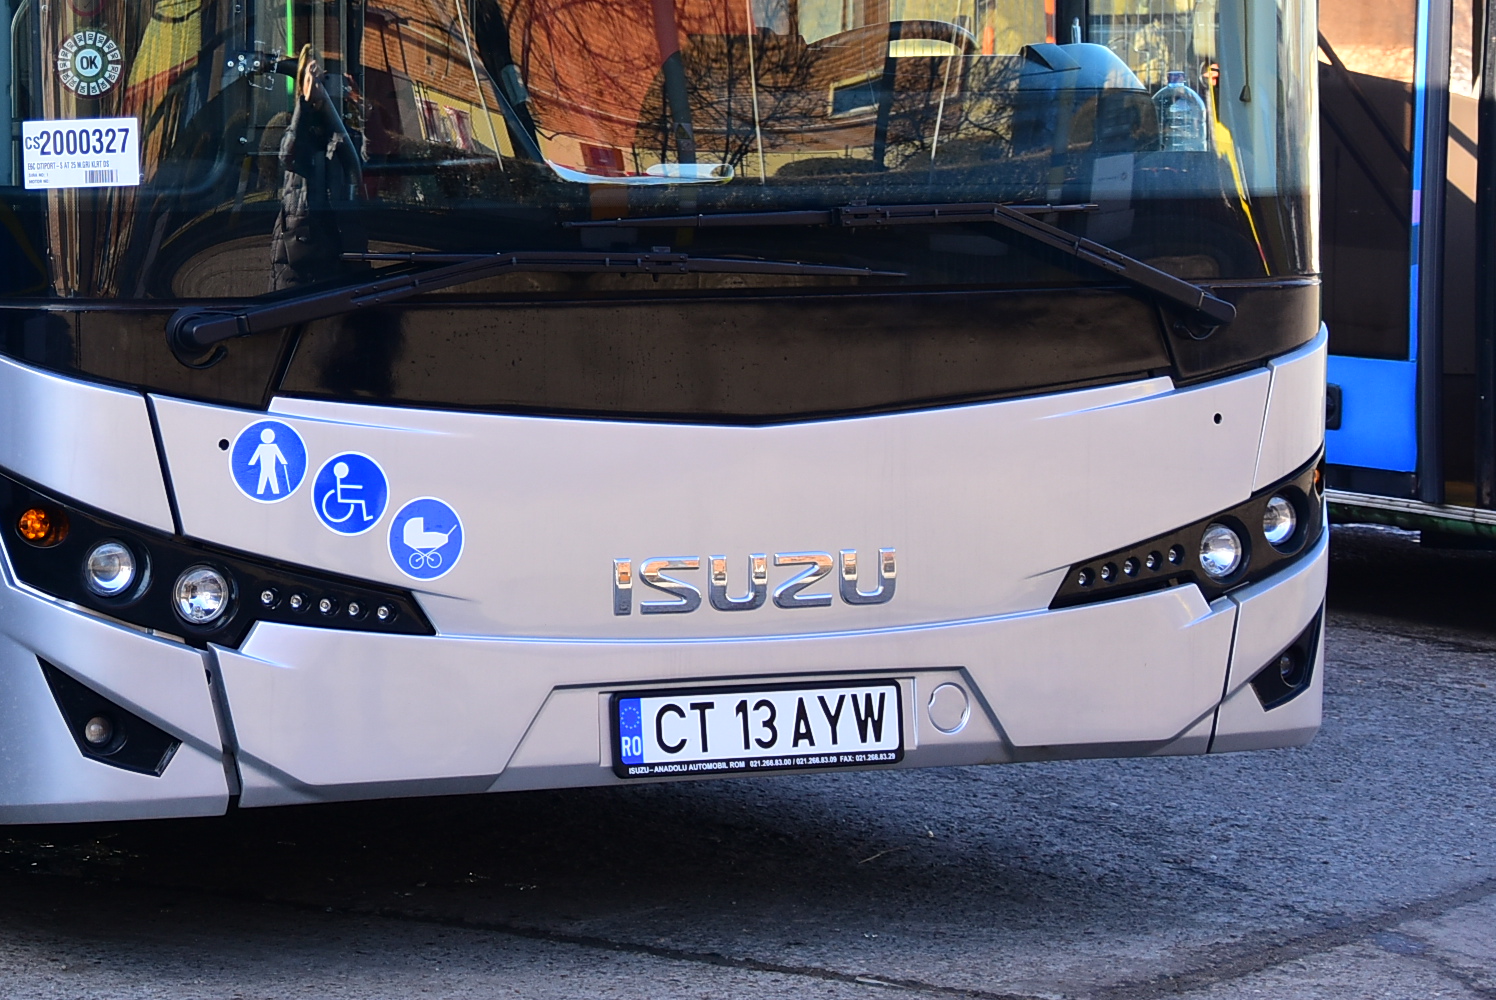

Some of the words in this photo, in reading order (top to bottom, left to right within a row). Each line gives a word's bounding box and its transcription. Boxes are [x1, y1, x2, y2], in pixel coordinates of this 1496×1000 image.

[80, 55, 98, 70] OK
[612, 547, 897, 616] ISUZU
[654, 701, 715, 755] CT
[734, 698, 778, 751] 13
[791, 691, 886, 749] AYW
[621, 735, 642, 758] RO
[688, 762, 729, 771] AUTOMOBIL
[729, 760, 745, 769] ROM
[839, 754, 854, 763] FAX:
